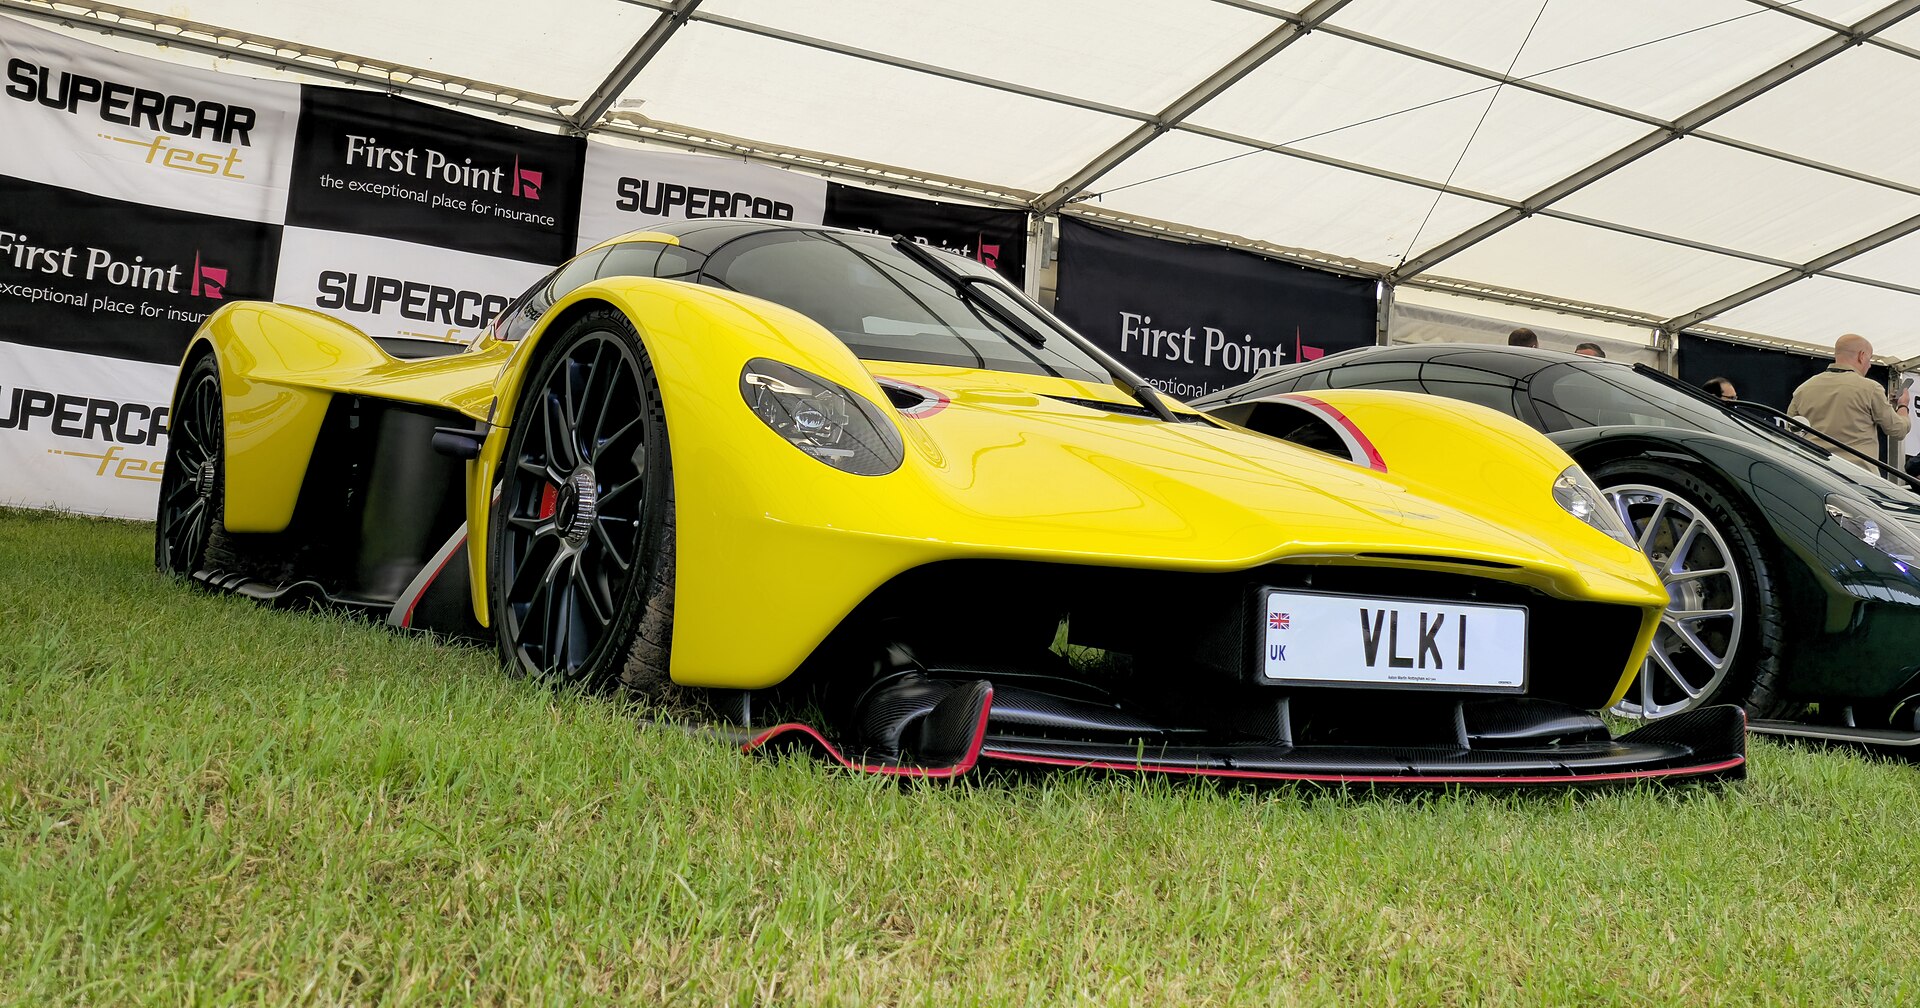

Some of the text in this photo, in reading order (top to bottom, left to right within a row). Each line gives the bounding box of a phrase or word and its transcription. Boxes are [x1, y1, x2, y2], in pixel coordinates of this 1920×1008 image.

[5, 58, 256, 147] SUPERCAR
[120, 135, 245, 179] fest
[345, 134, 505, 194] First Point
[319, 174, 555, 227] the exceptional place for insurance
[86, 247, 182, 294] Point
[92, 296, 135, 313] place
[140, 301, 164, 318] for
[167, 305, 211, 323] insur
[315, 270, 517, 329] SUPERCA
[1118, 310, 1286, 375] First Point
[1269, 644, 1286, 661] UK
[1359, 607, 1445, 670] VLK
